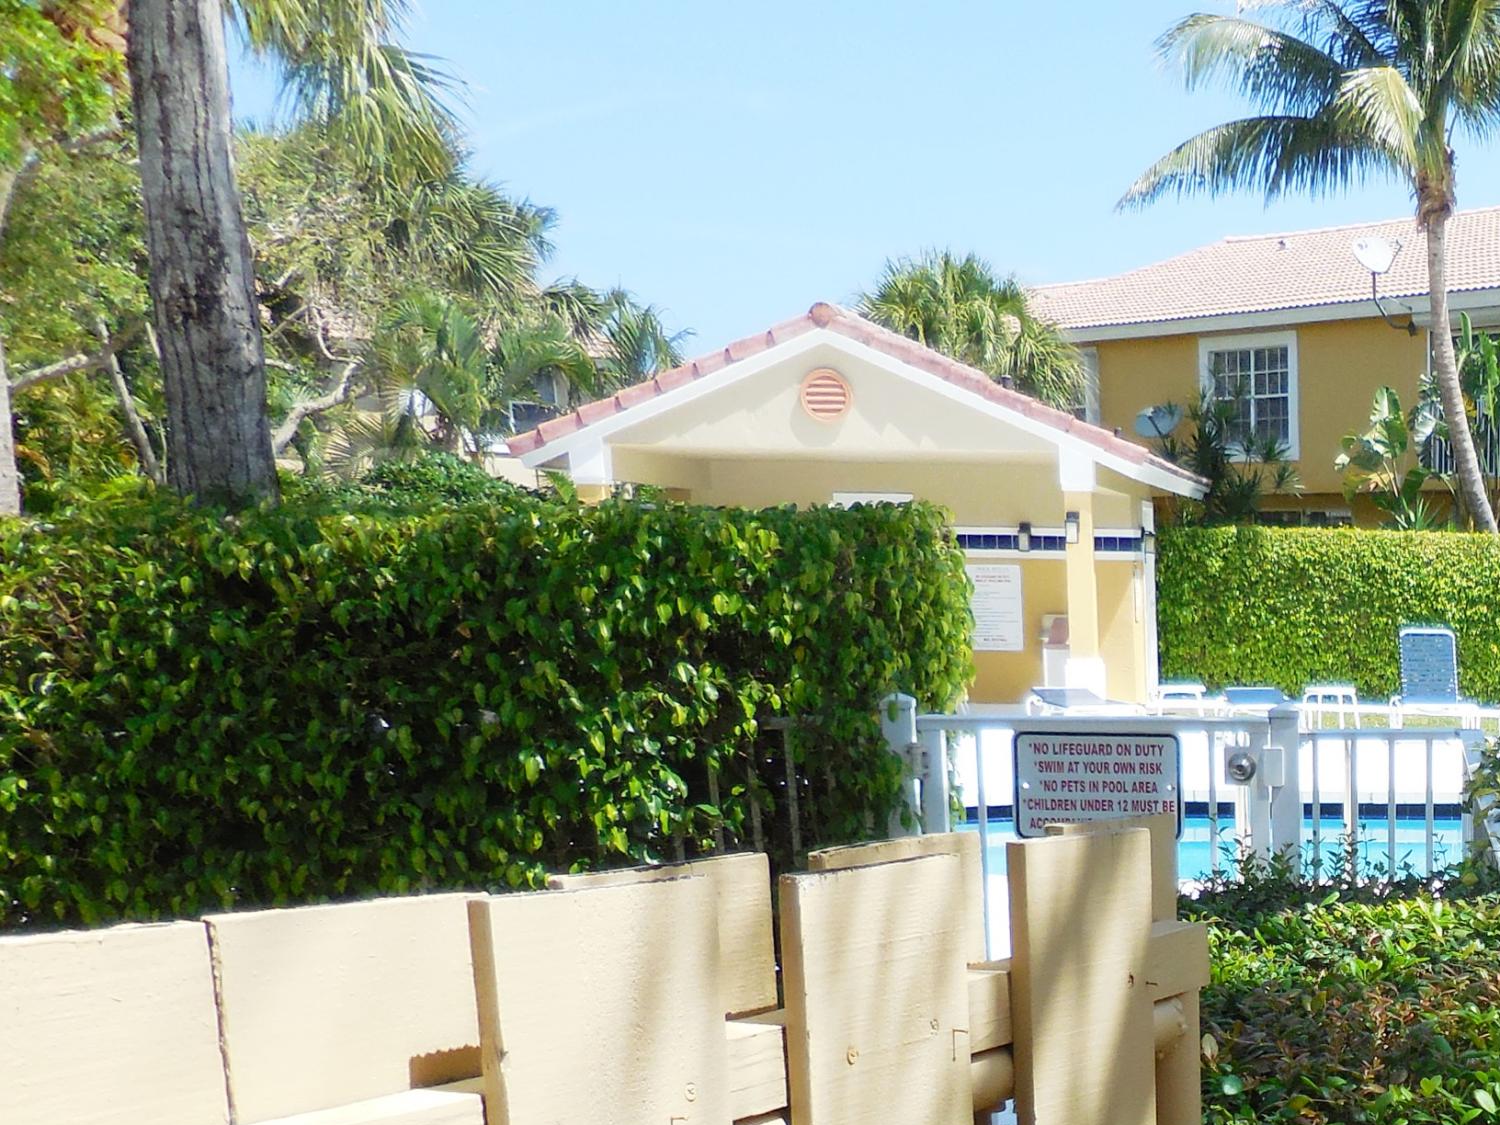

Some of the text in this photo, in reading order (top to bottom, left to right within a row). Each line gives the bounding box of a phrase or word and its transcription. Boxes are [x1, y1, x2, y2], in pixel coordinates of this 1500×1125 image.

[1053, 743, 1112, 756] LIFEGUARD
[1116, 744, 1131, 756] ON
[1135, 745, 1164, 757] DUTY
[1068, 761, 1080, 773] AT
[1084, 762, 1110, 774] YOUR
[1113, 762, 1136, 774] OWN
[1139, 763, 1163, 775] RISK
[1061, 780, 1086, 792] PETS
[1089, 781, 1099, 792] IN
[1102, 781, 1128, 793] POOL
[1131, 782, 1158, 793] AREA
[1080, 800, 1114, 812] UNDER
[1117, 800, 1128, 812] 12
[1131, 801, 1159, 812] MUST
[1162, 801, 1175, 812] BE
